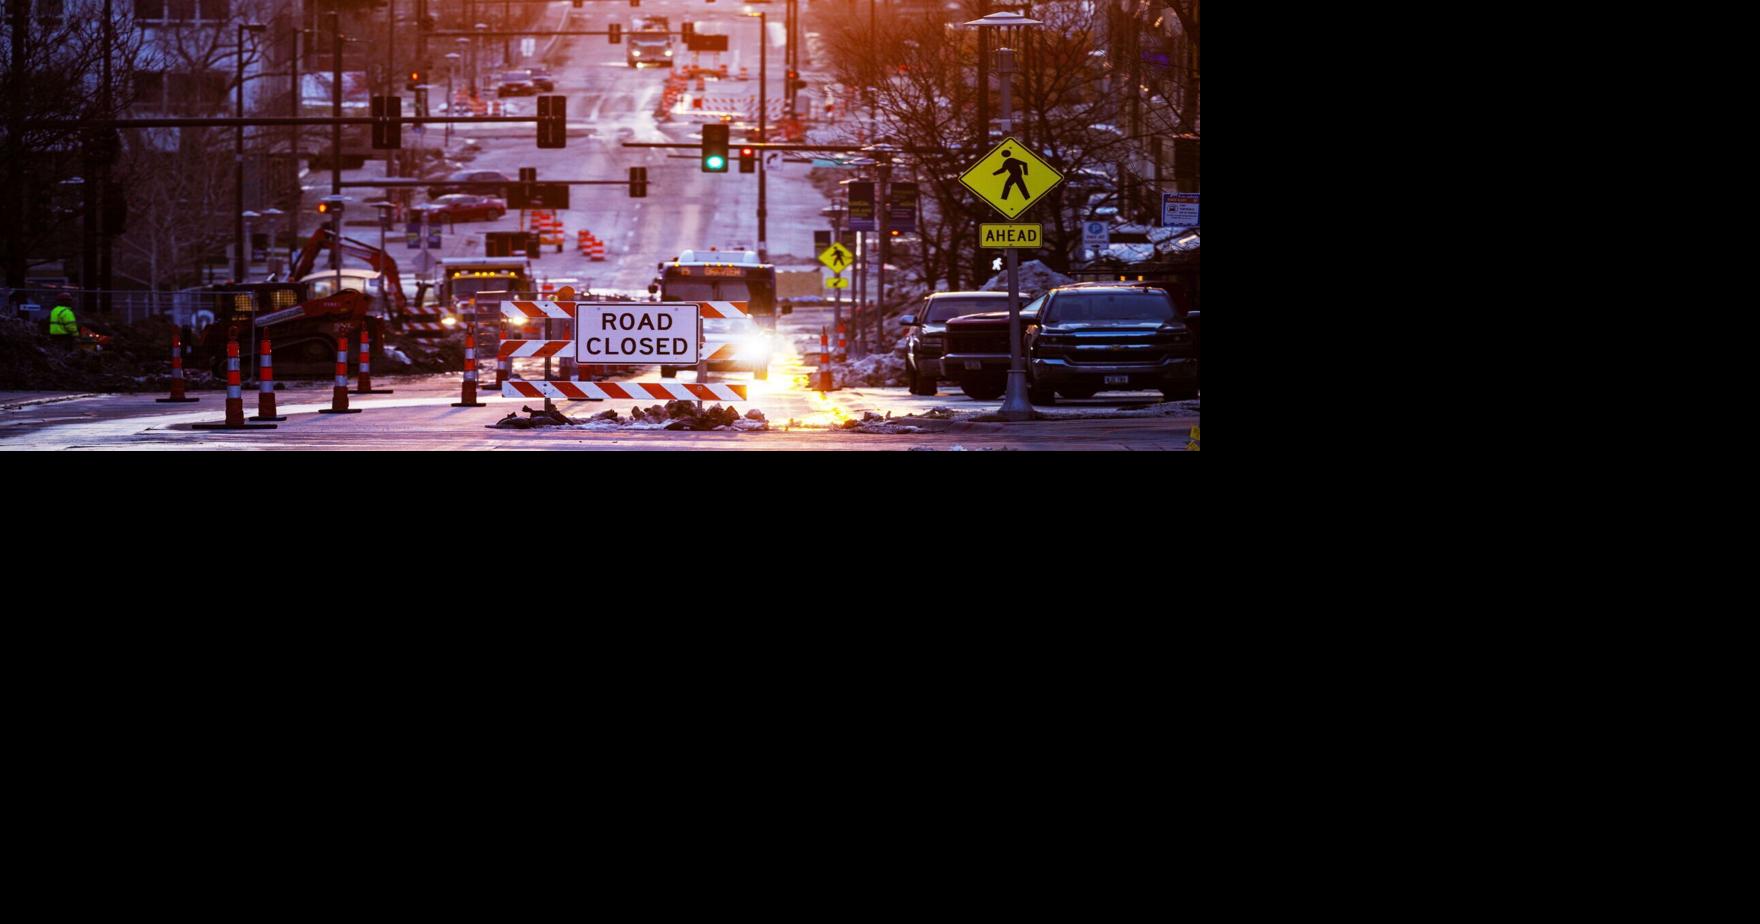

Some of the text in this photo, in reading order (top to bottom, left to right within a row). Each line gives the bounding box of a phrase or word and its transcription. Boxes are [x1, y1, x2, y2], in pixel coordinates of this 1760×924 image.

[985, 229, 1037, 242] AHEAD
[601, 313, 673, 331] ROAD
[586, 337, 688, 355] CLOSED
